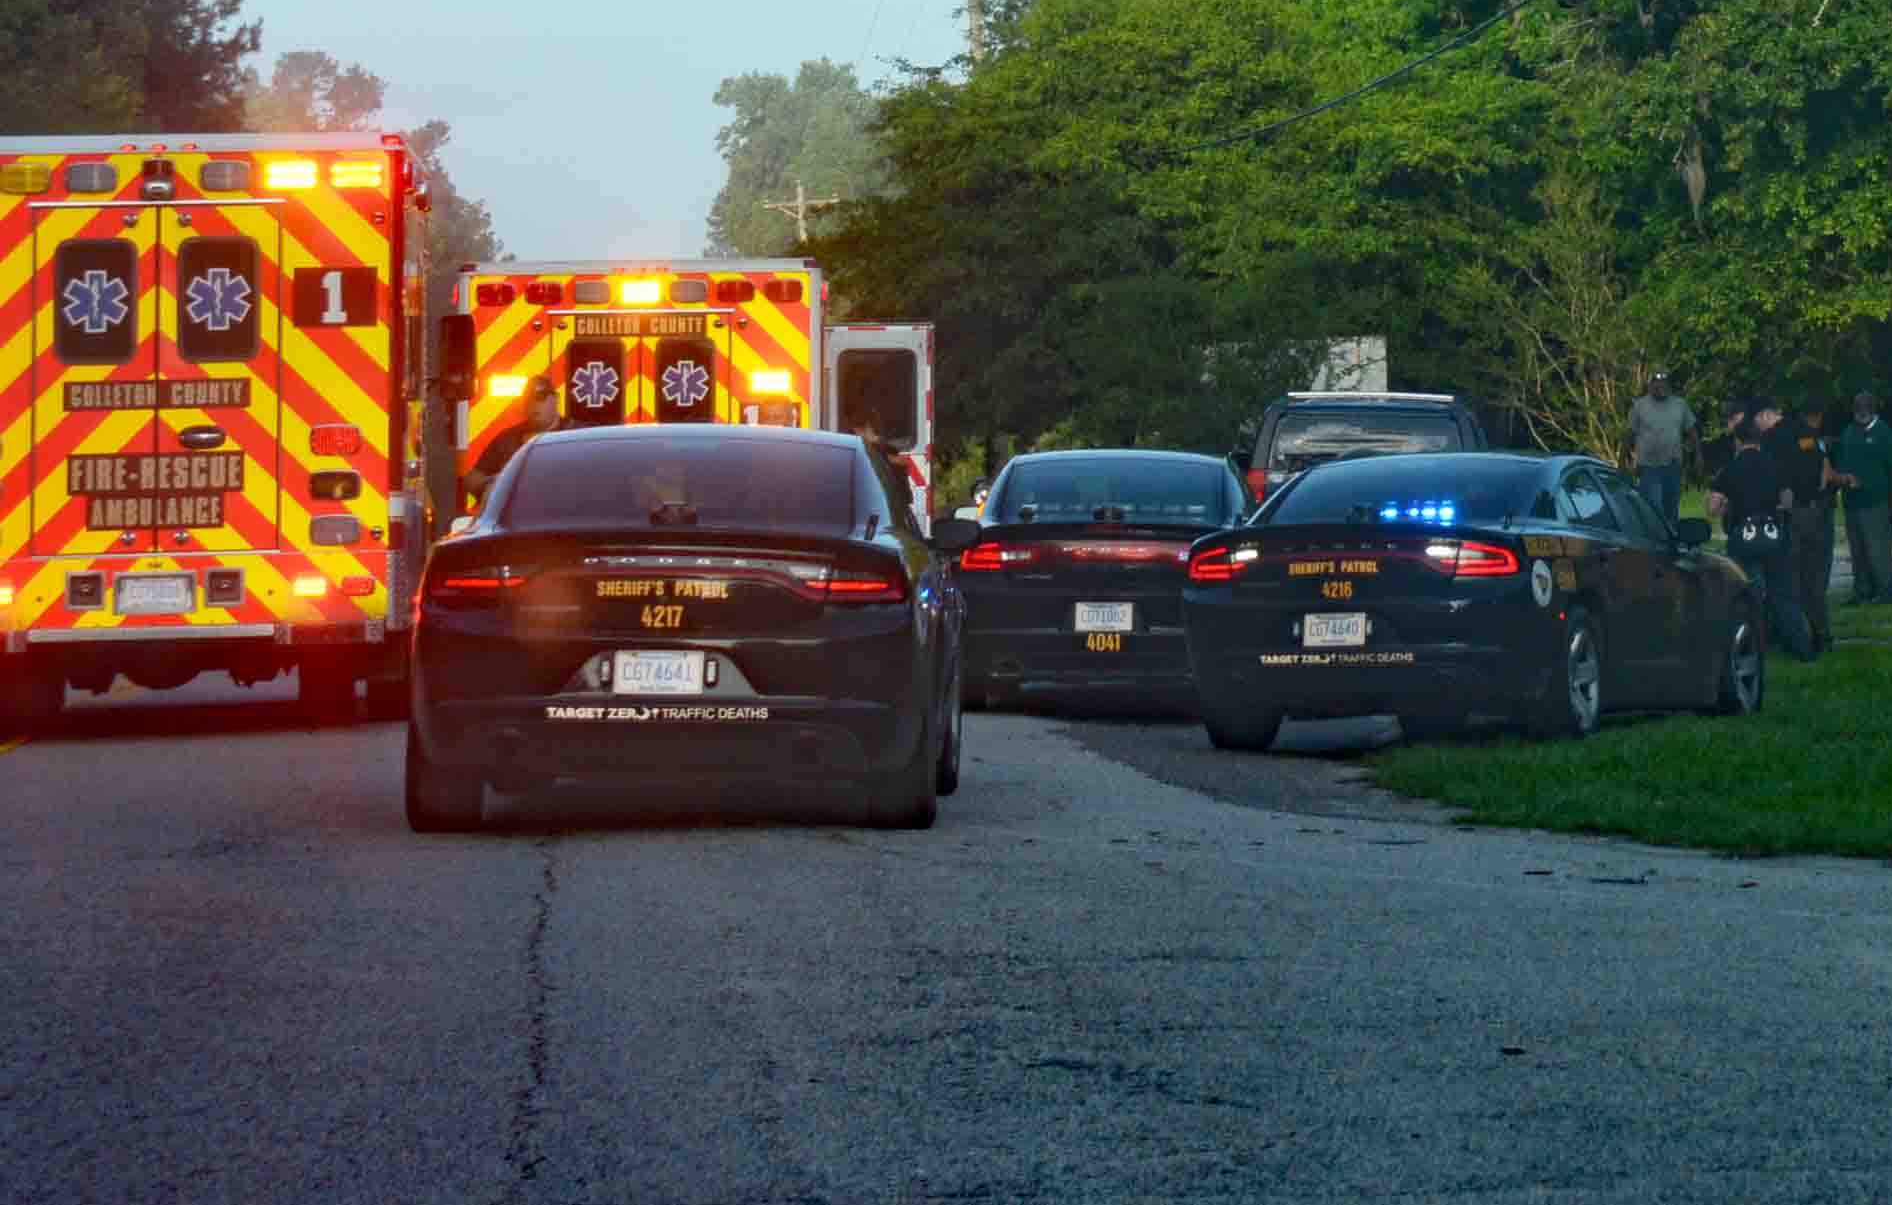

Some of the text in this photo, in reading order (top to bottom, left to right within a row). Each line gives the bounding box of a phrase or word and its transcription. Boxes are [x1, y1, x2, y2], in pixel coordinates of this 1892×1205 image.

[320, 271, 347, 323] 1
[576, 315, 703, 335] COLLETON COUNTY
[70, 382, 243, 408] COLLETON COUNTY
[70, 456, 241, 491] FIRE-RESCUE
[90, 496, 221, 528] AMBULANCE
[1341, 560, 1379, 573] PATROL
[597, 580, 729, 599] SHERIFF'S PATROL
[1321, 580, 1353, 599] 4216
[641, 604, 685, 628] 4217
[1087, 632, 1121, 652] 4041
[545, 707, 605, 719] TARGET
[661, 707, 715, 719] TRAFFIC
[717, 707, 769, 719] DEATHS
